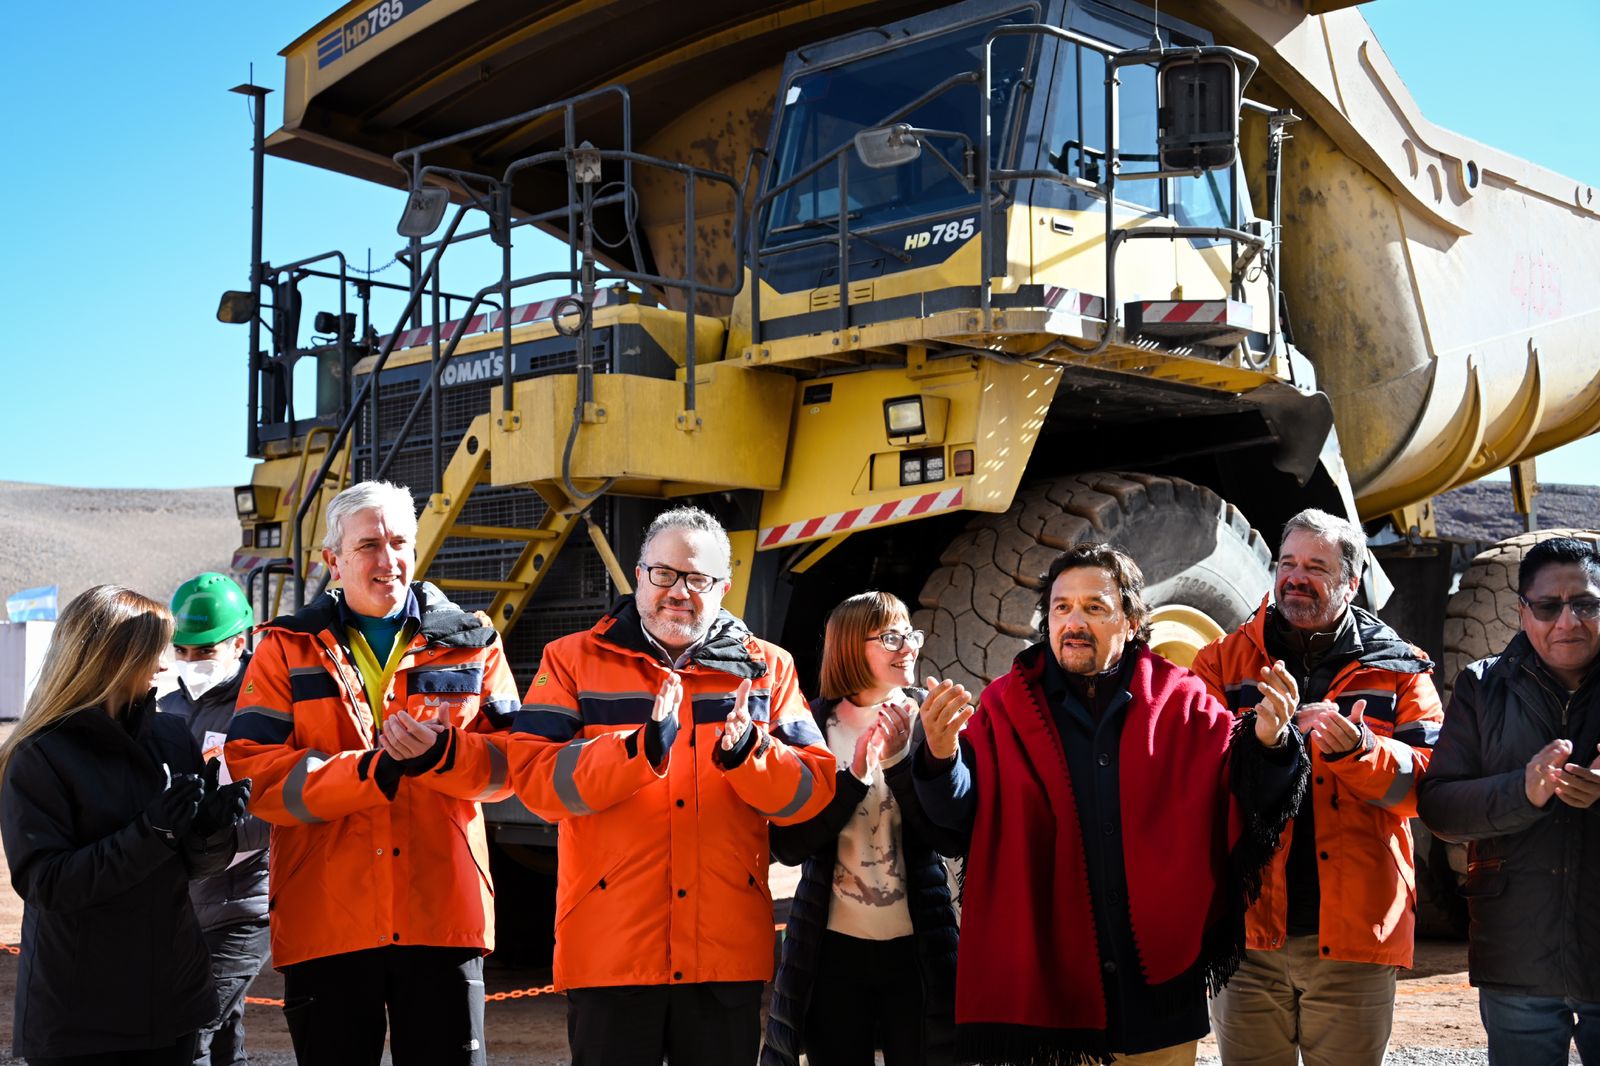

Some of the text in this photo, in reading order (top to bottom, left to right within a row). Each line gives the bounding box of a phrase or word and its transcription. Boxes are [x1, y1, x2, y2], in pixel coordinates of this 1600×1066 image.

[345, 0, 404, 50] HD785
[904, 218, 975, 251] HD785
[440, 351, 516, 386] OMATS
